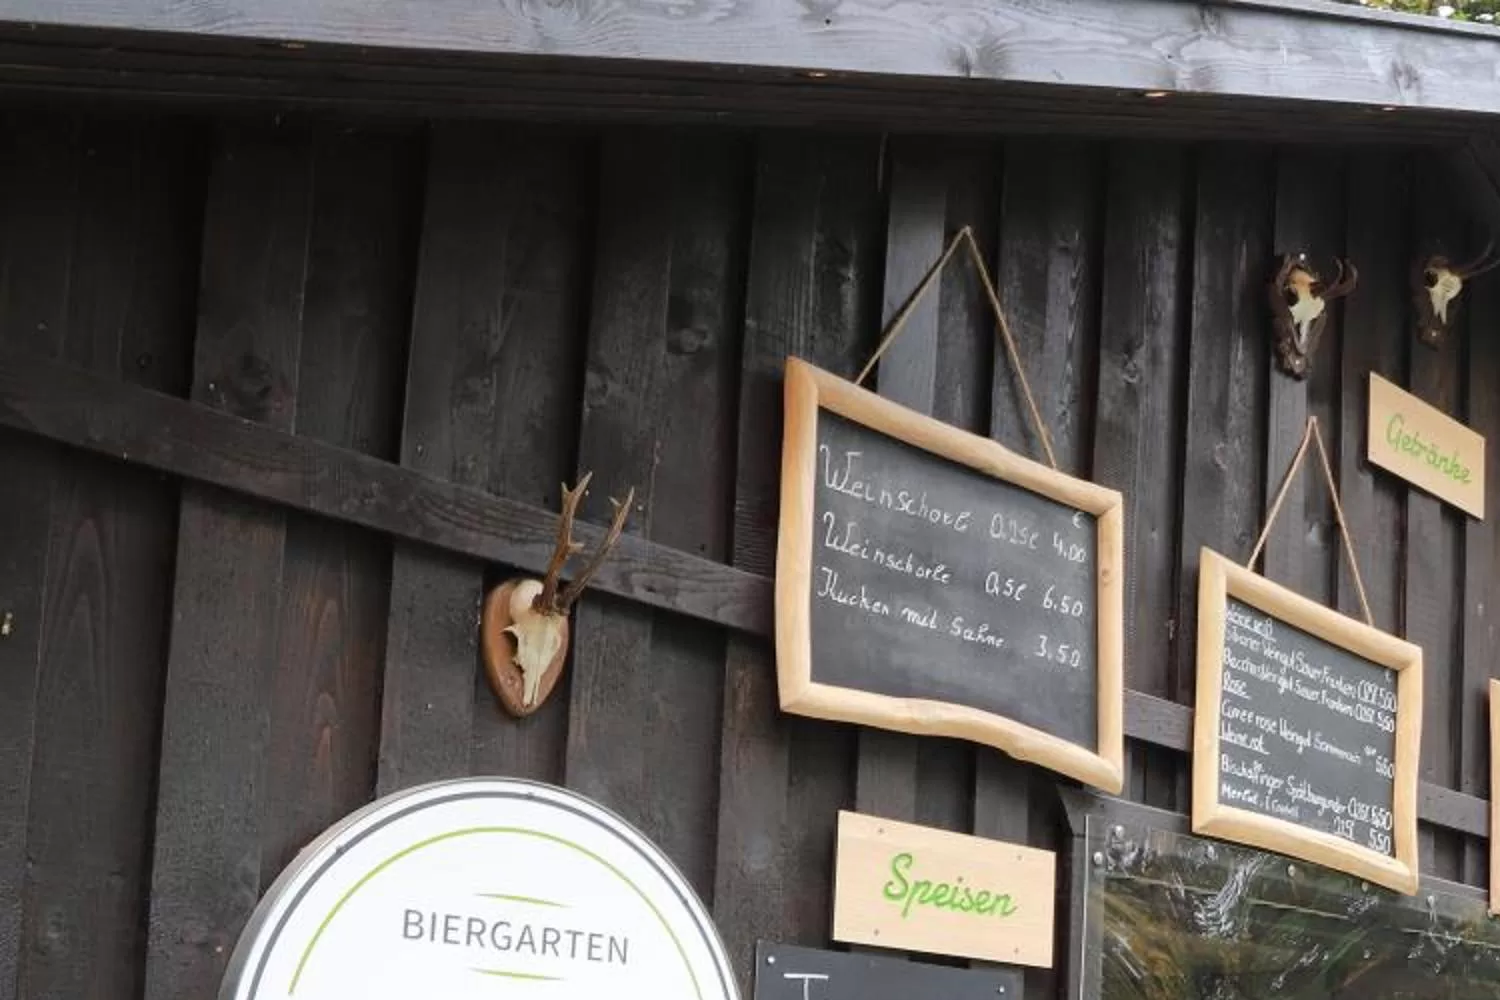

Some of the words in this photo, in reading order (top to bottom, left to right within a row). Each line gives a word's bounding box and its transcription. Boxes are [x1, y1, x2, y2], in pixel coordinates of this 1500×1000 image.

[1386, 413, 1472, 484] Getränke
[824, 511, 951, 583] Weinschorle
[818, 566, 890, 617] Kuchen
[902, 606, 938, 631] mit
[950, 616, 1005, 648] Sahne
[883, 852, 1018, 919] Speisen
[403, 909, 630, 965] BIERGARTEN
